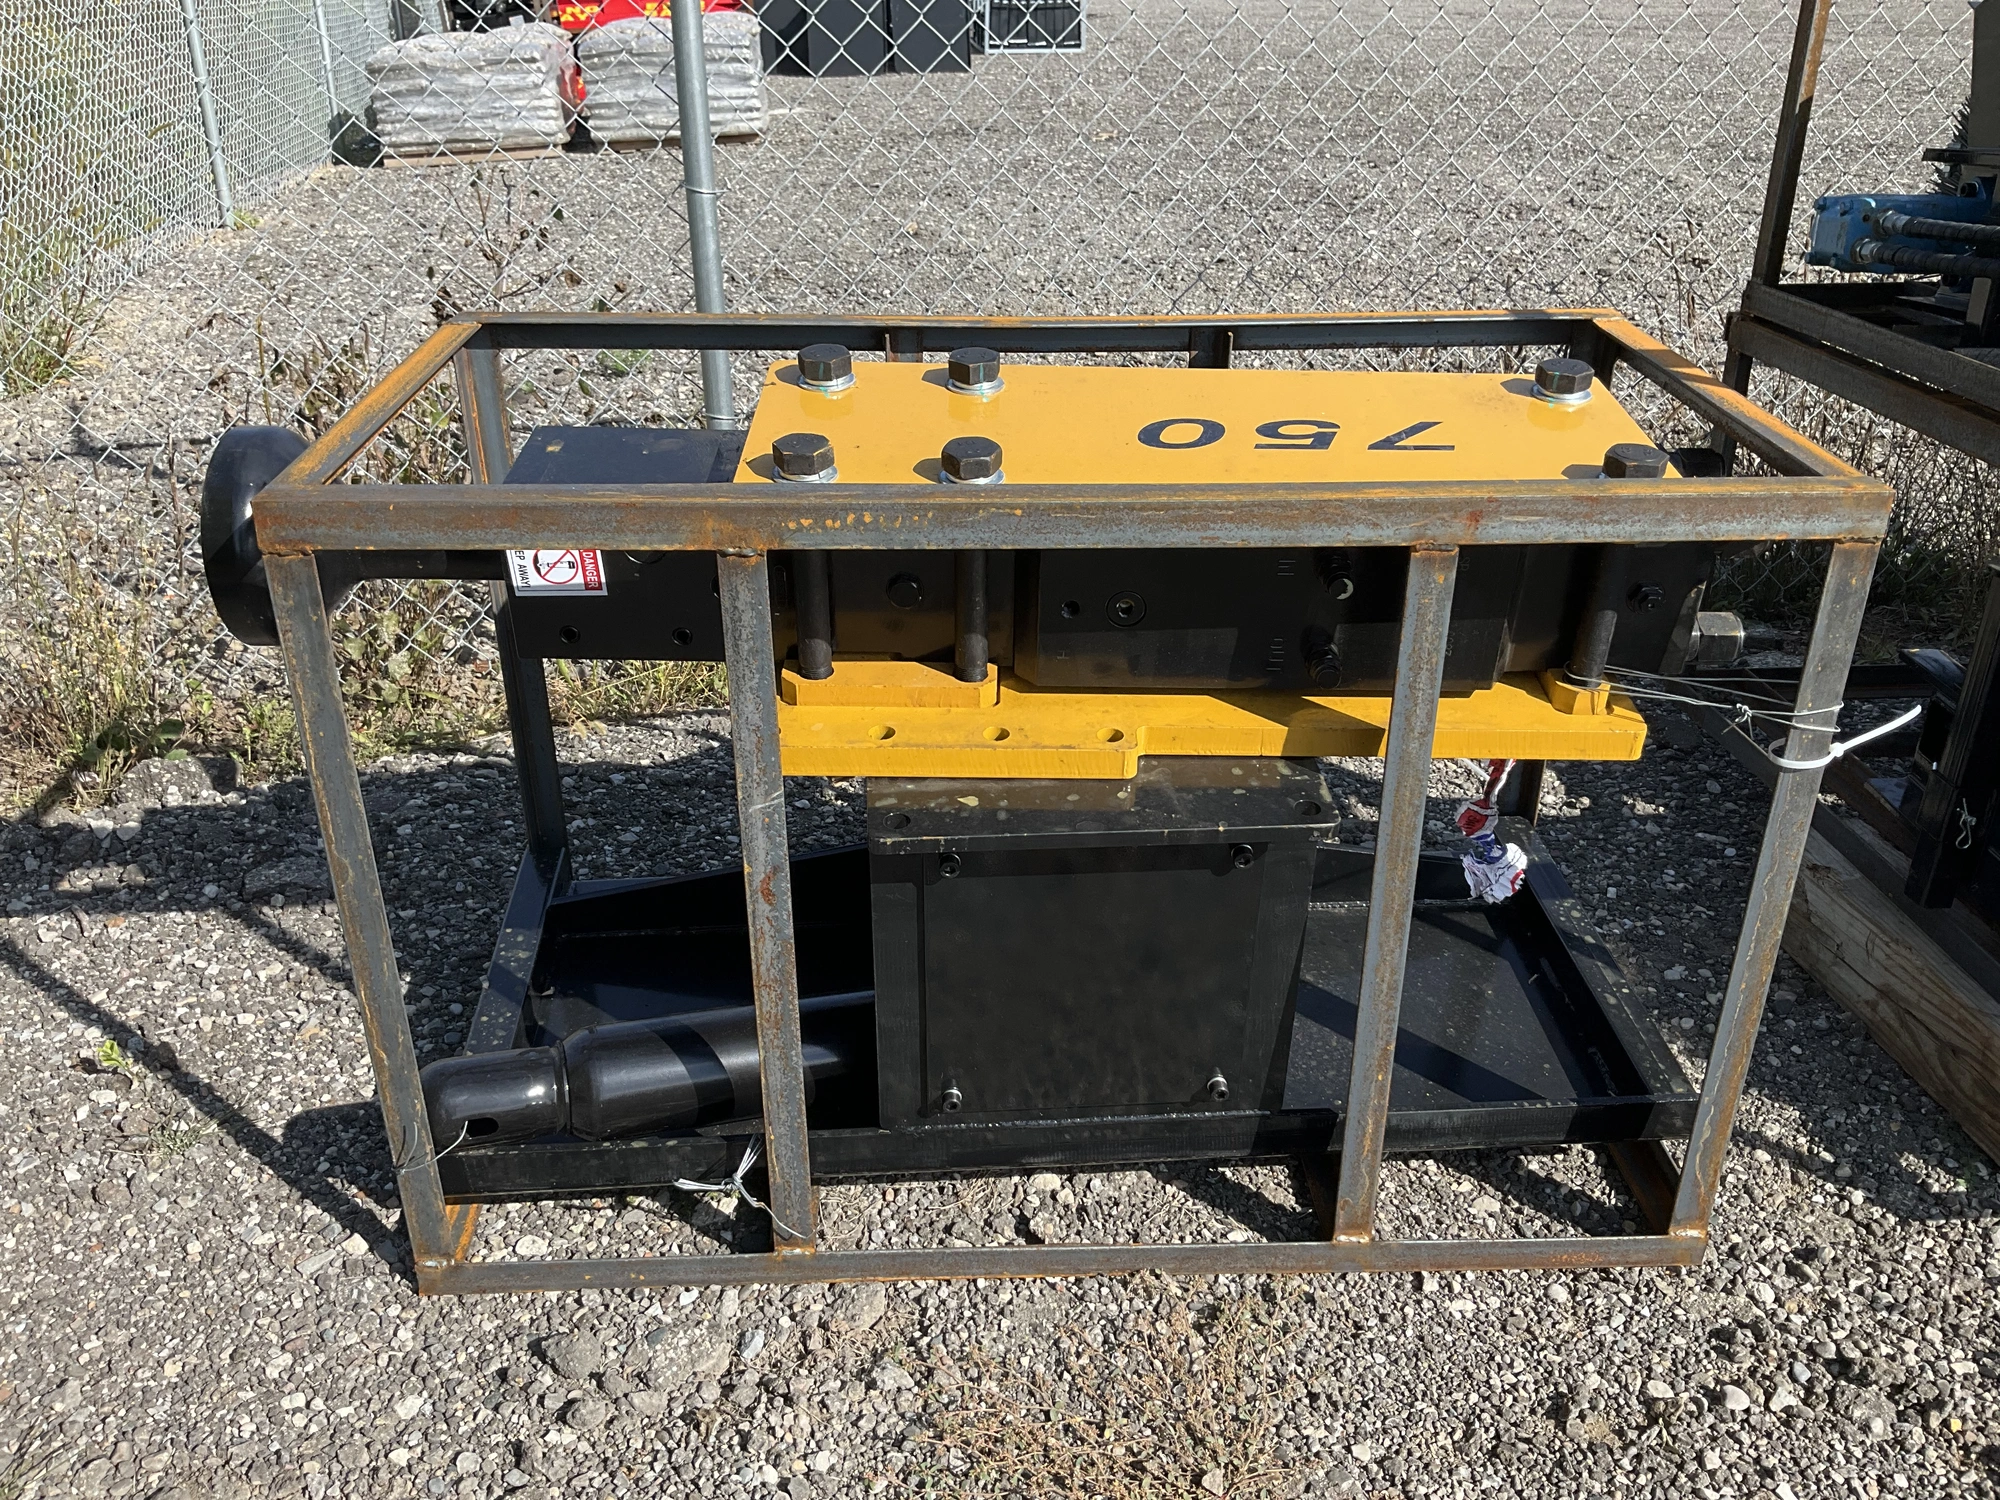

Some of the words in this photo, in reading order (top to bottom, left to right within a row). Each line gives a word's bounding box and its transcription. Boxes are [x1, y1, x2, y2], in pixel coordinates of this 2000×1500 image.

[1138, 418, 1456, 450] 750
[514, 550, 525, 560] EP
[582, 551, 599, 587] DANGER
